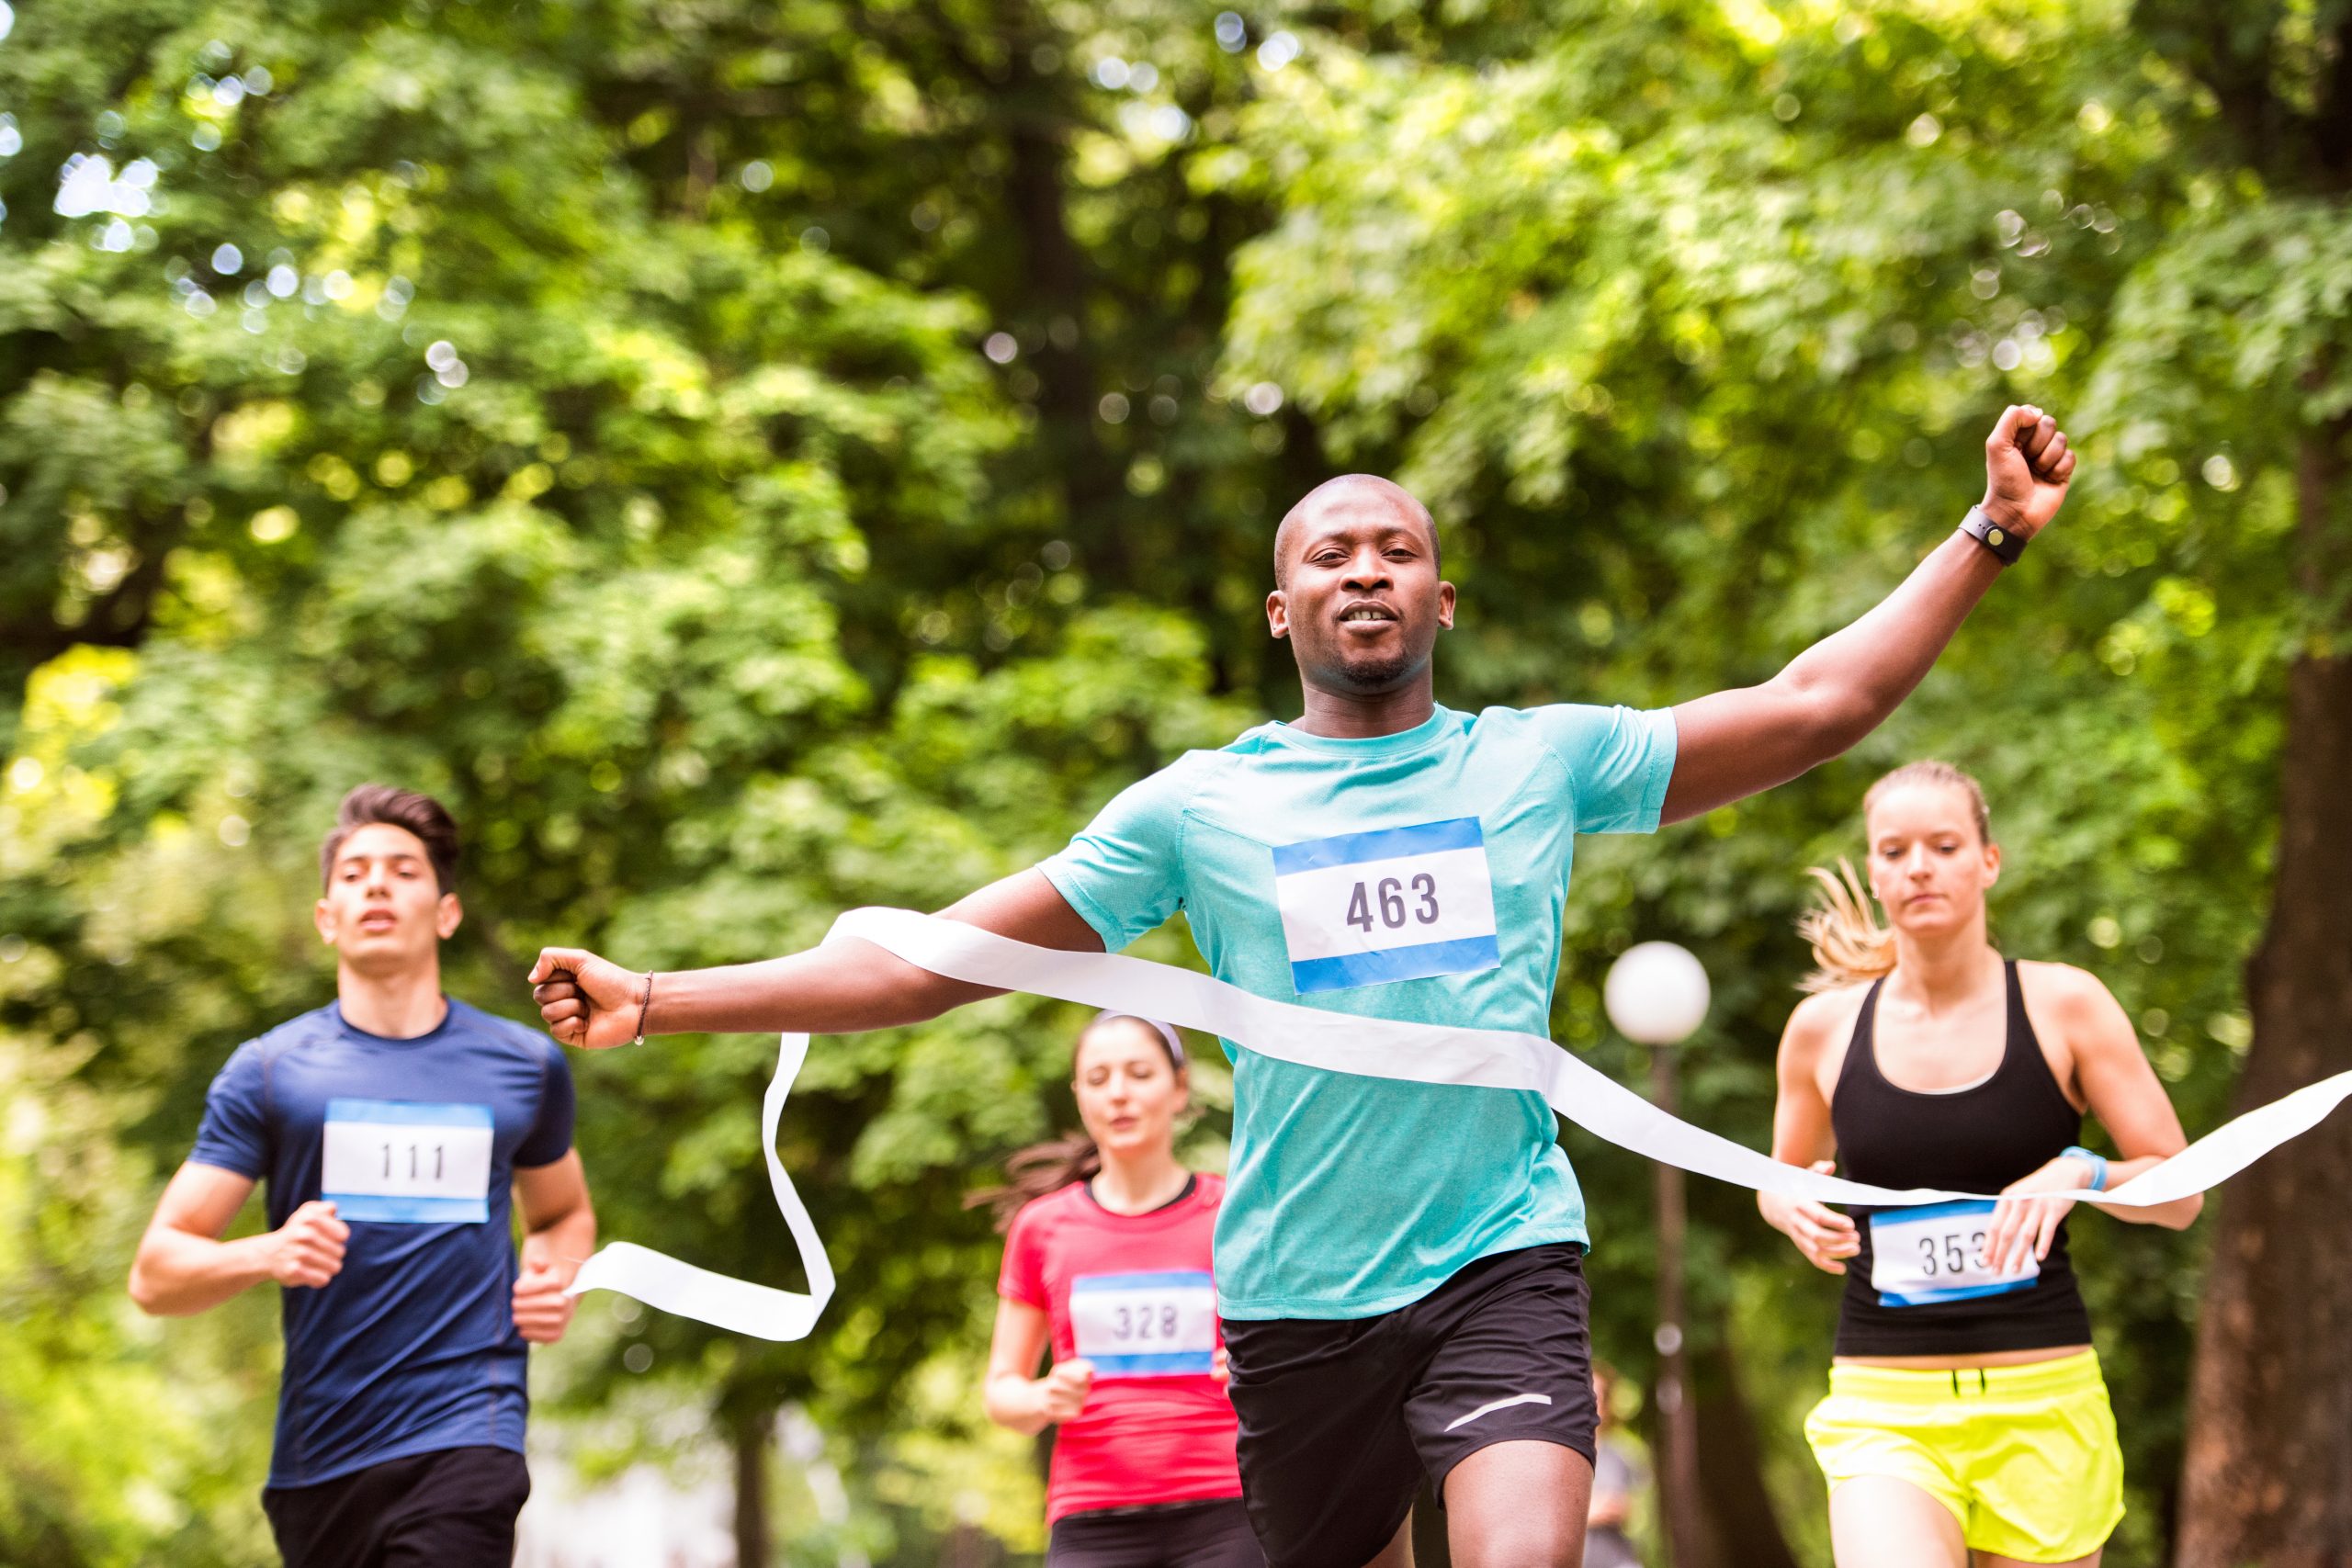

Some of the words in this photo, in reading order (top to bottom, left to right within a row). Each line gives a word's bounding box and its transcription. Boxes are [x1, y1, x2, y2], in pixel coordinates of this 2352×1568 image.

[1346, 873, 1440, 932] 463
[382, 1144, 443, 1179] 111
[1113, 1305, 1178, 1341] 328
